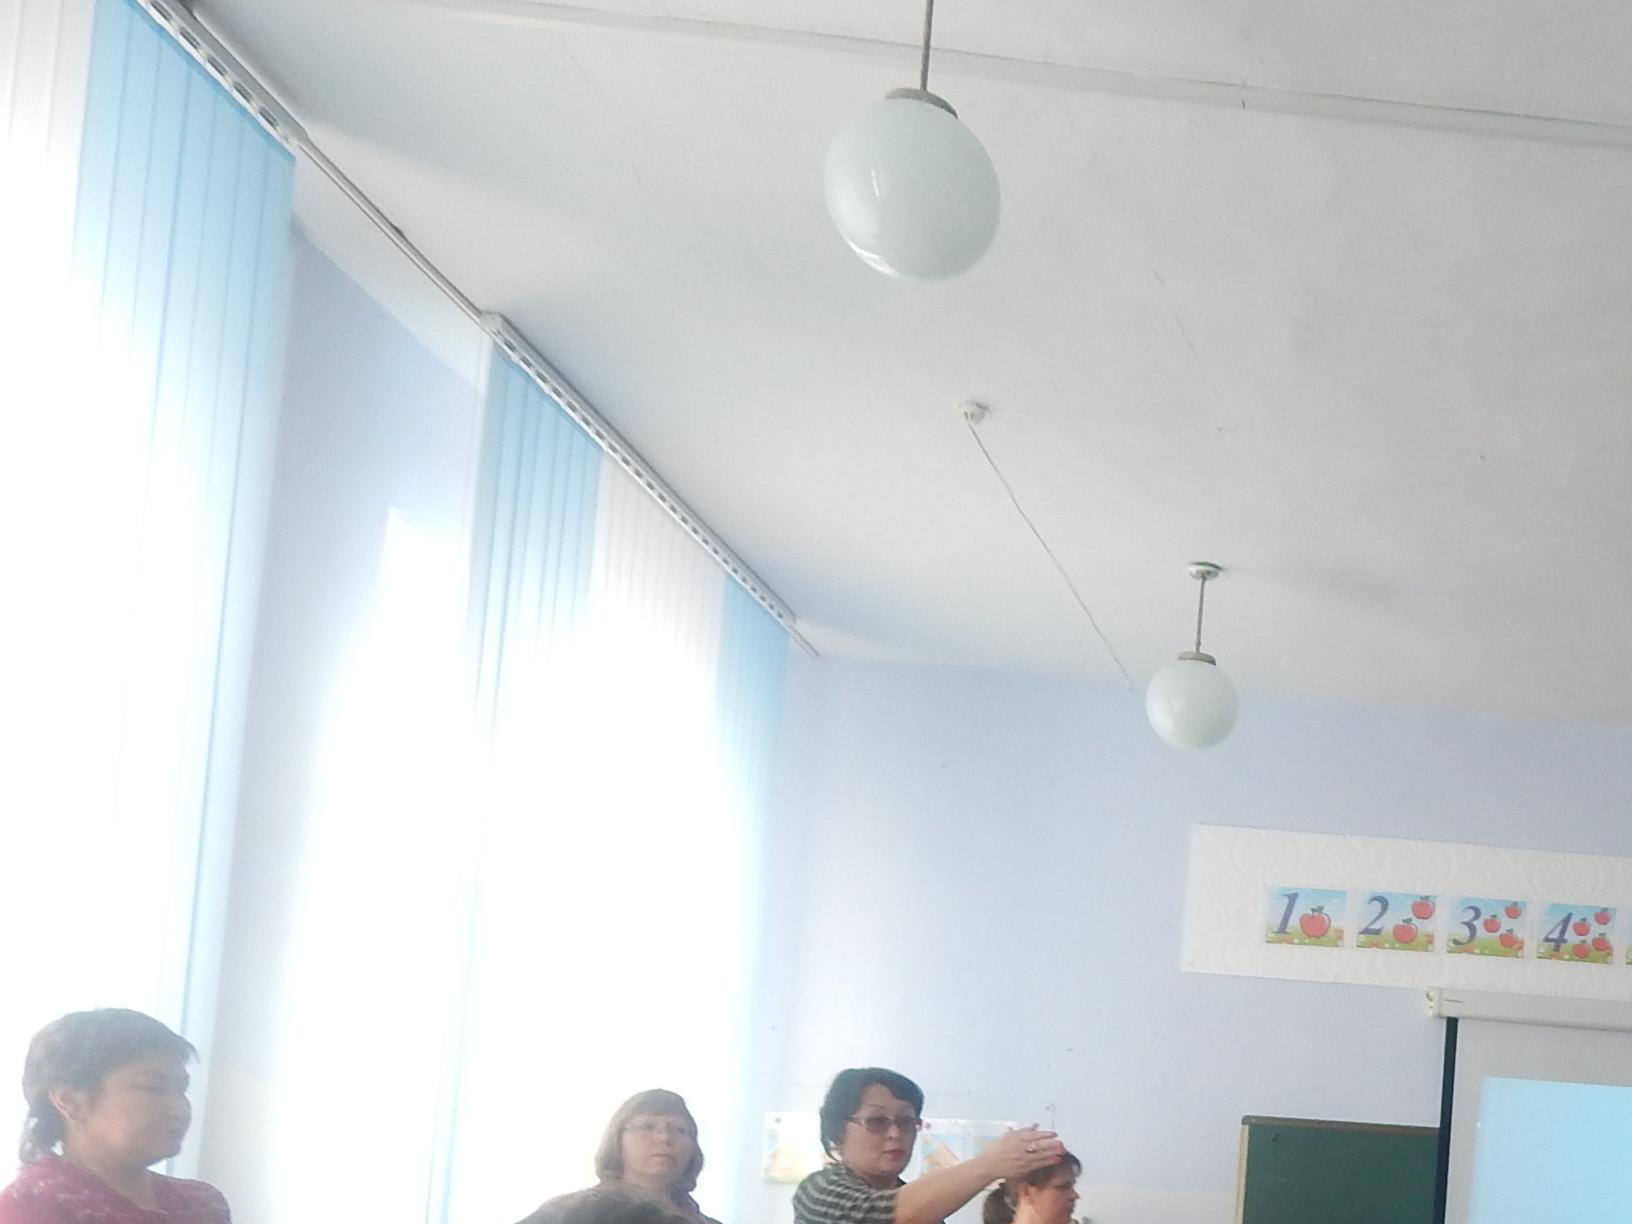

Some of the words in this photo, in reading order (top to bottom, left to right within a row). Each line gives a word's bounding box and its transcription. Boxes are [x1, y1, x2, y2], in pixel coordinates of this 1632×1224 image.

[1271, 892, 1300, 934] 1
[1359, 895, 1389, 936] 2
[1451, 905, 1482, 945] 3
[1543, 911, 1575, 952] 4
